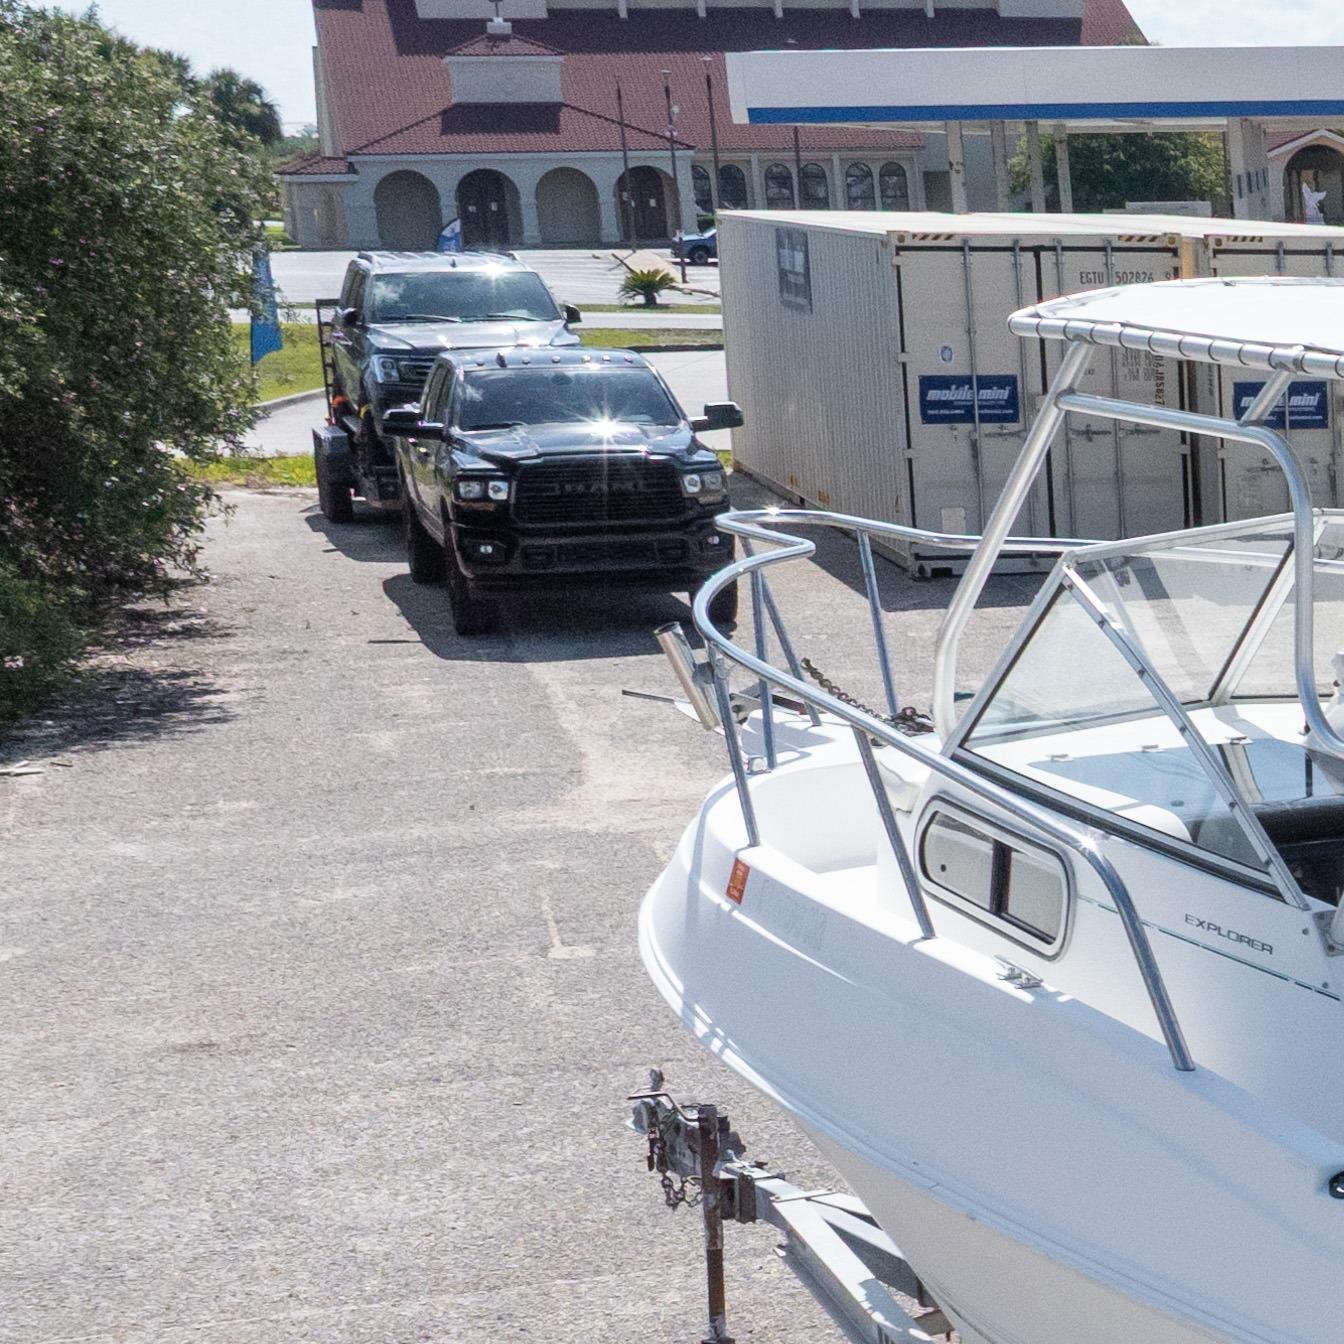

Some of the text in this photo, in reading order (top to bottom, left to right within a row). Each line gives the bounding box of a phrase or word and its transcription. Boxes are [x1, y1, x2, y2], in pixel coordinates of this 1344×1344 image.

[1079, 271, 1104, 284] EGTU
[926, 384, 1012, 401] mobile mini
[1289, 392, 1322, 406] mini
[1184, 913, 1274, 955] EXPLORER
